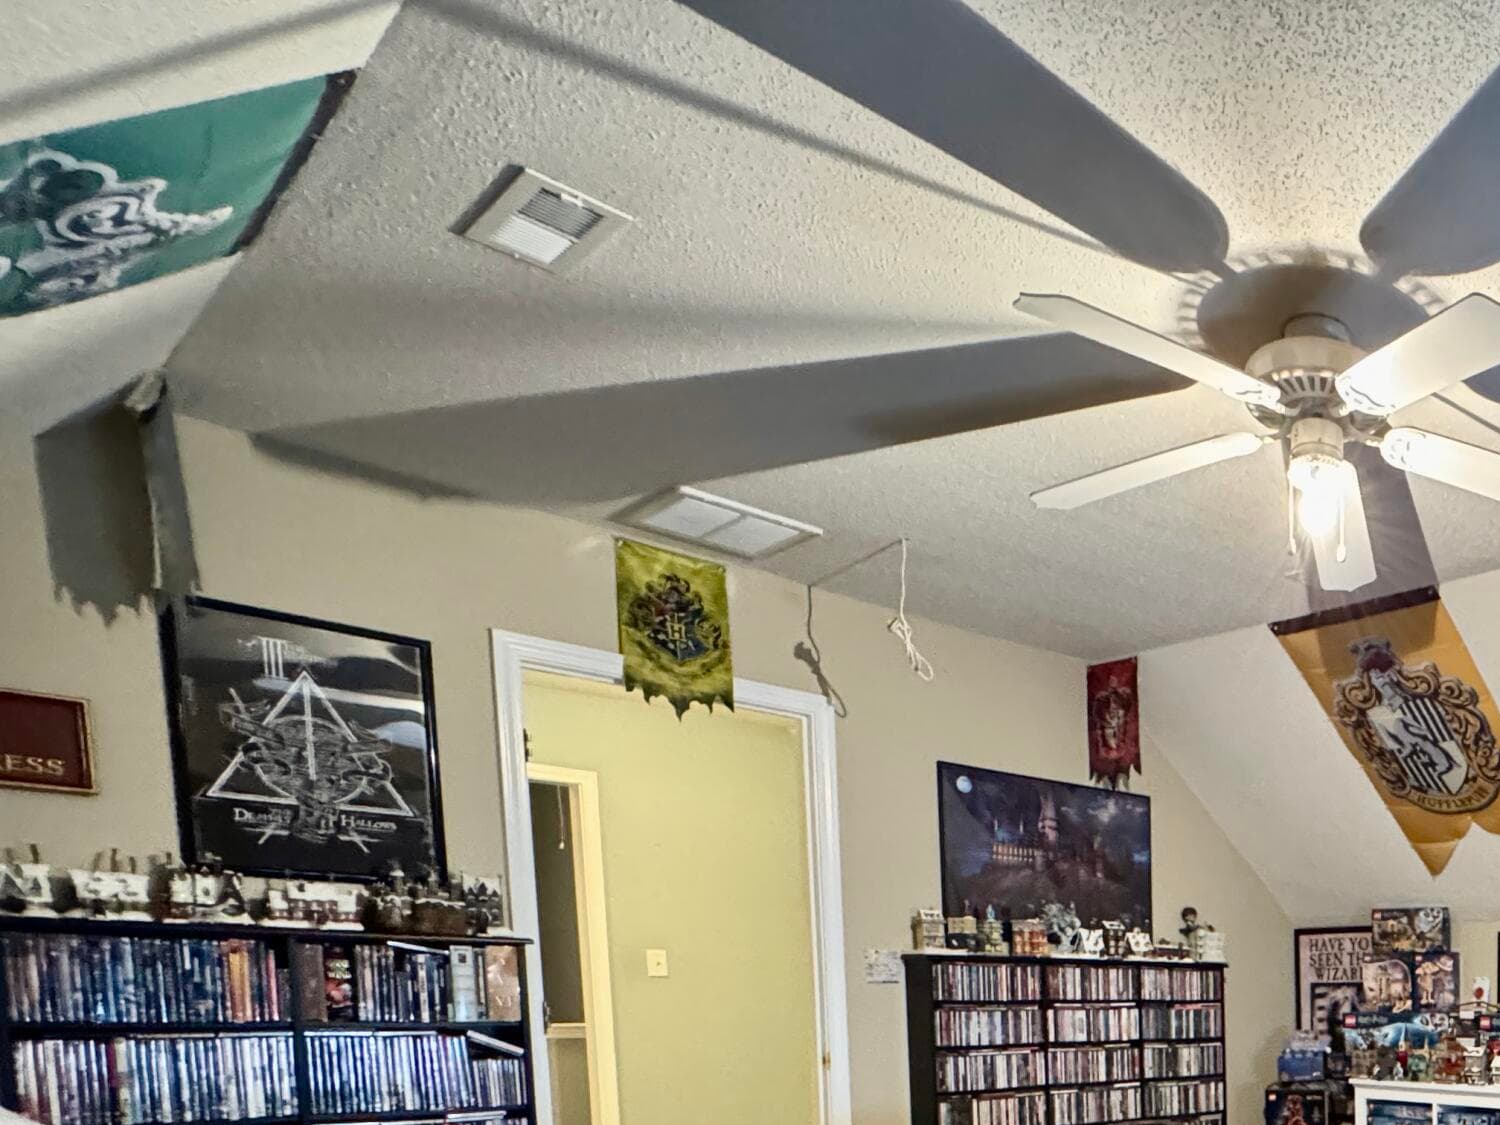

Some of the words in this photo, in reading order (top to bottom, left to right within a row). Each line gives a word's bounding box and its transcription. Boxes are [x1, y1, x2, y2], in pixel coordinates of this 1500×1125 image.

[0, 754, 65, 776] ESS
[1309, 937, 1345, 952] HAVE
[1349, 937, 1369, 951] YO
[1309, 951, 1343, 968] SEEN
